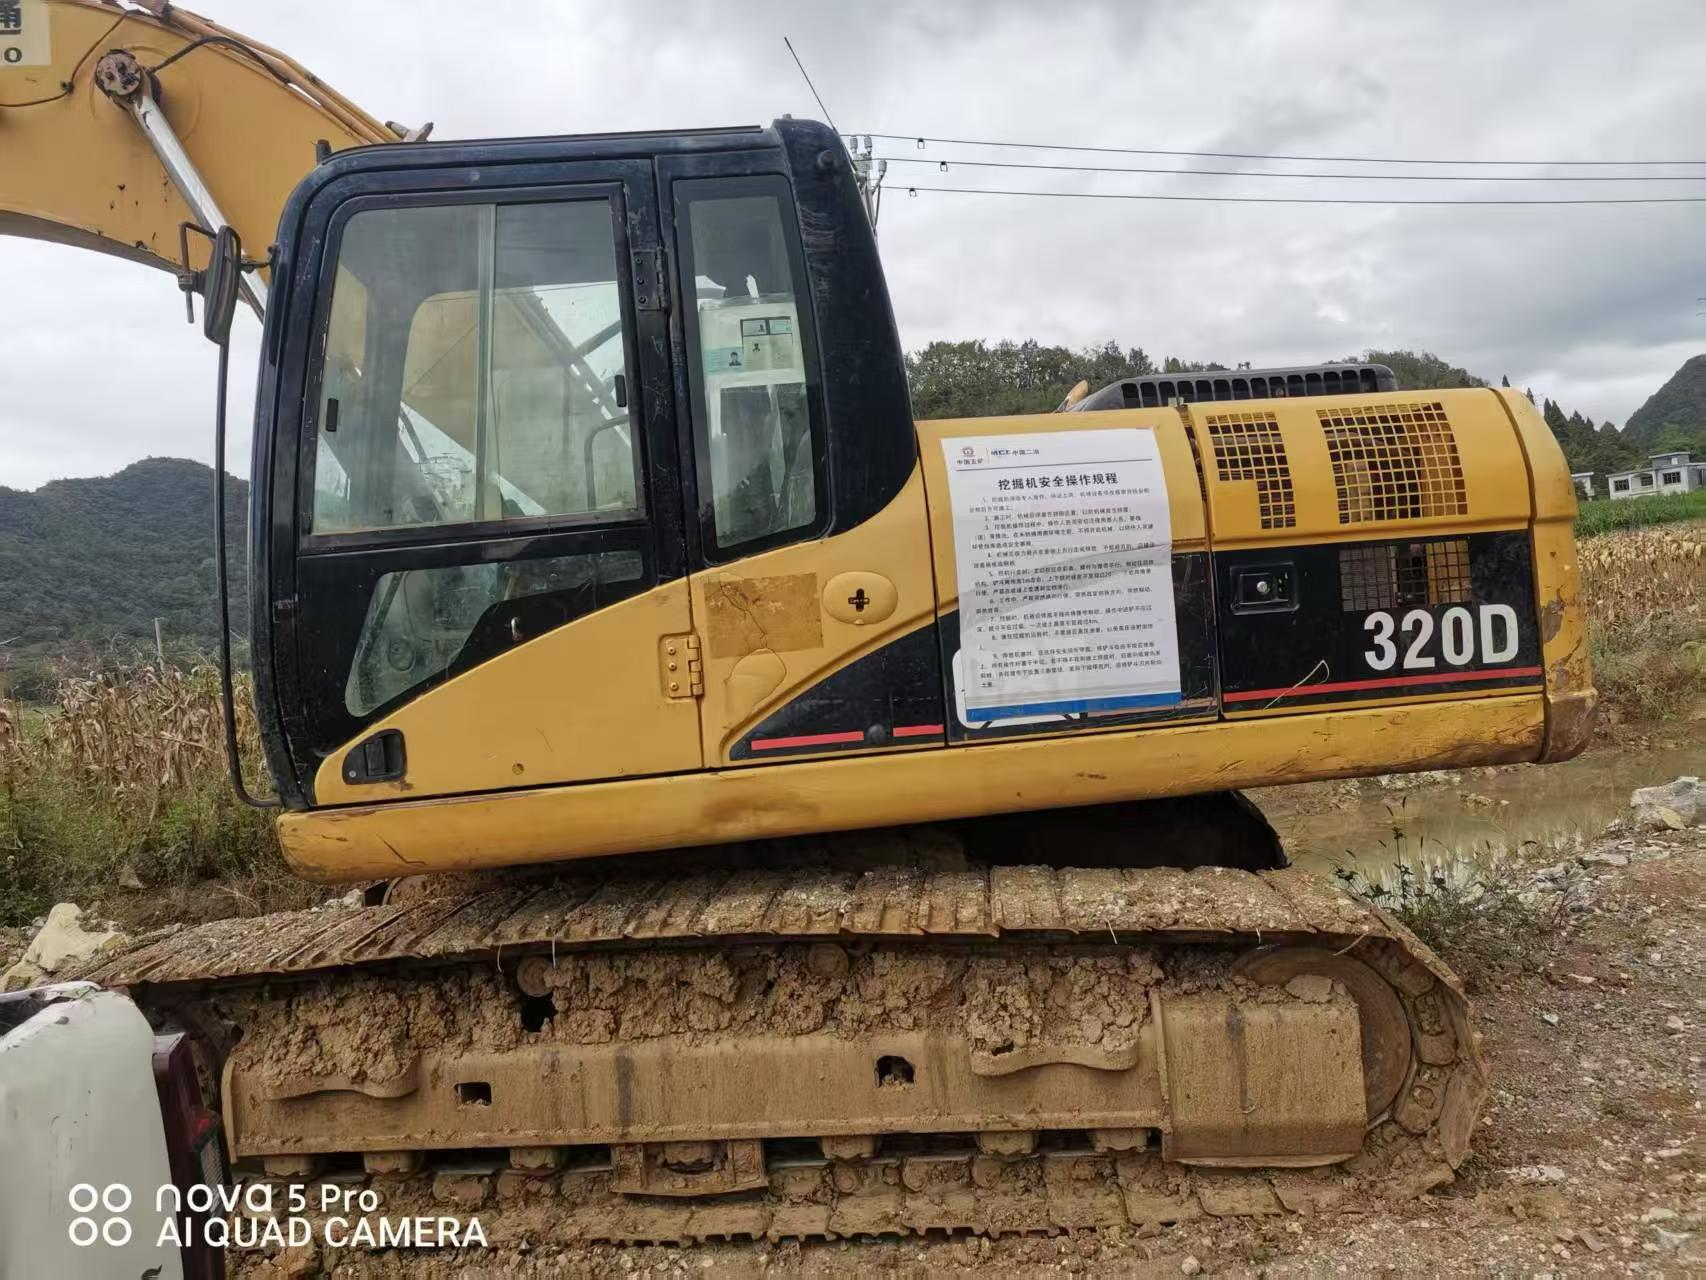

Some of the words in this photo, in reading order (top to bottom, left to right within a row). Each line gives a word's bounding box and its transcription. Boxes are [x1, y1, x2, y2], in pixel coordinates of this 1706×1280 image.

[997, 472, 1119, 491] 挖掘机安全操作规程
[1363, 603, 1519, 671] 320D
